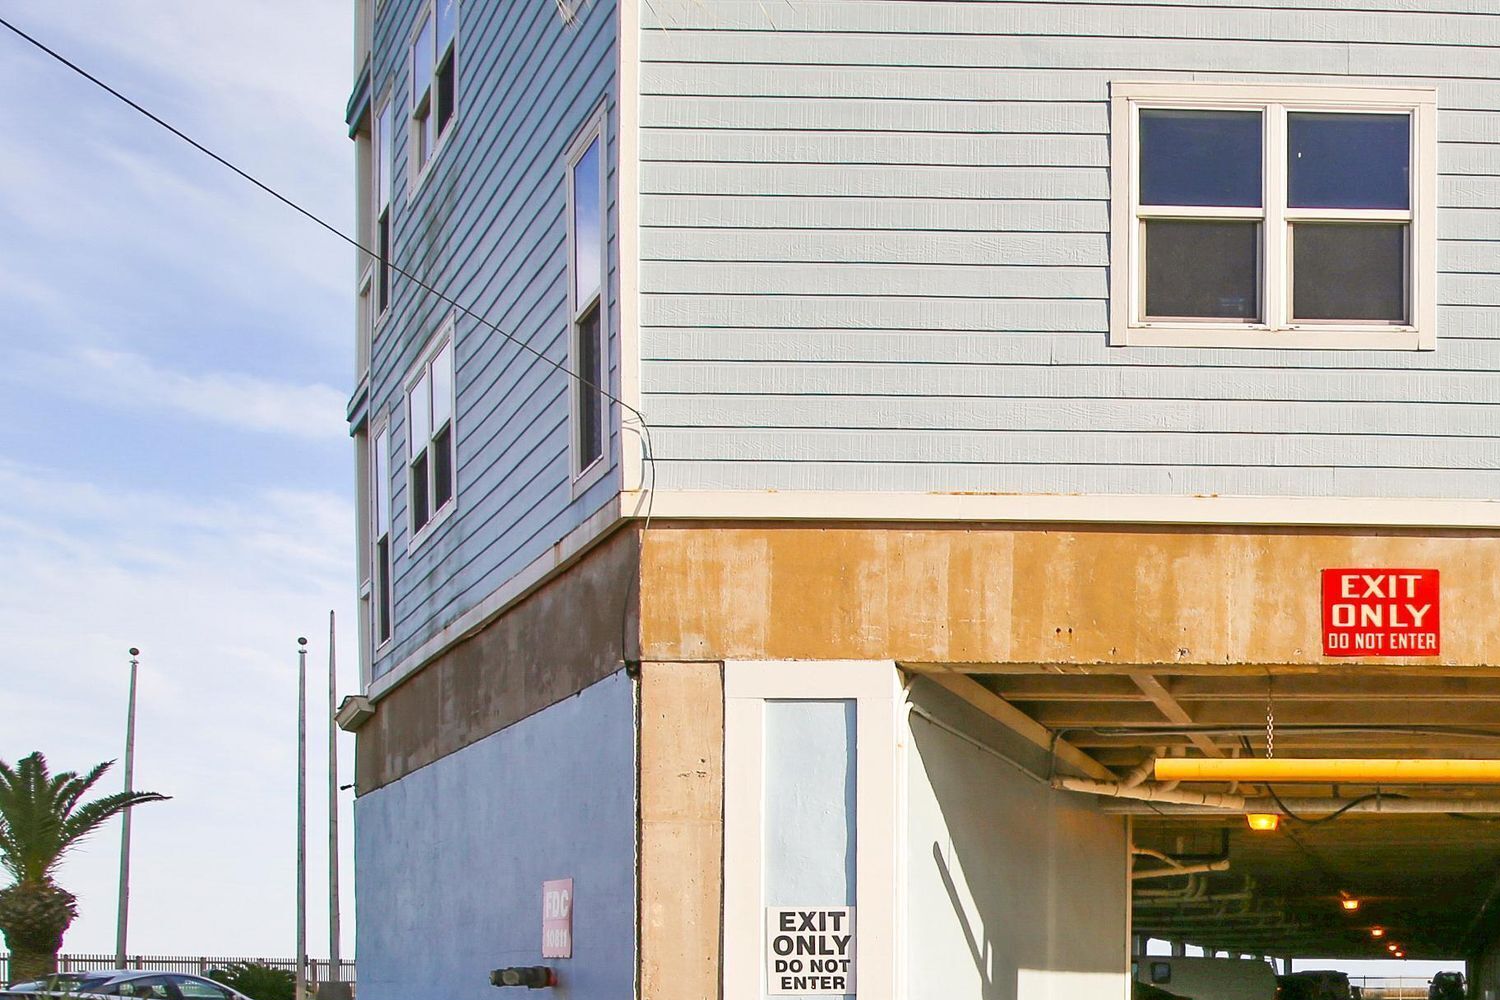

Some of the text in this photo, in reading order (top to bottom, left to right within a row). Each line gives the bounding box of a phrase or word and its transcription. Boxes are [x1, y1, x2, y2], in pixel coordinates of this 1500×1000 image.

[1341, 575, 1422, 598] EXIT
[1332, 604, 1431, 627] ONLY
[1328, 633, 1436, 649] DO NOT ENTER
[546, 889, 569, 918] FDC
[779, 911, 846, 932] EXIT
[773, 935, 852, 956] ONLY
[775, 959, 851, 973] DO NOT
[781, 976, 846, 990] ENTER
